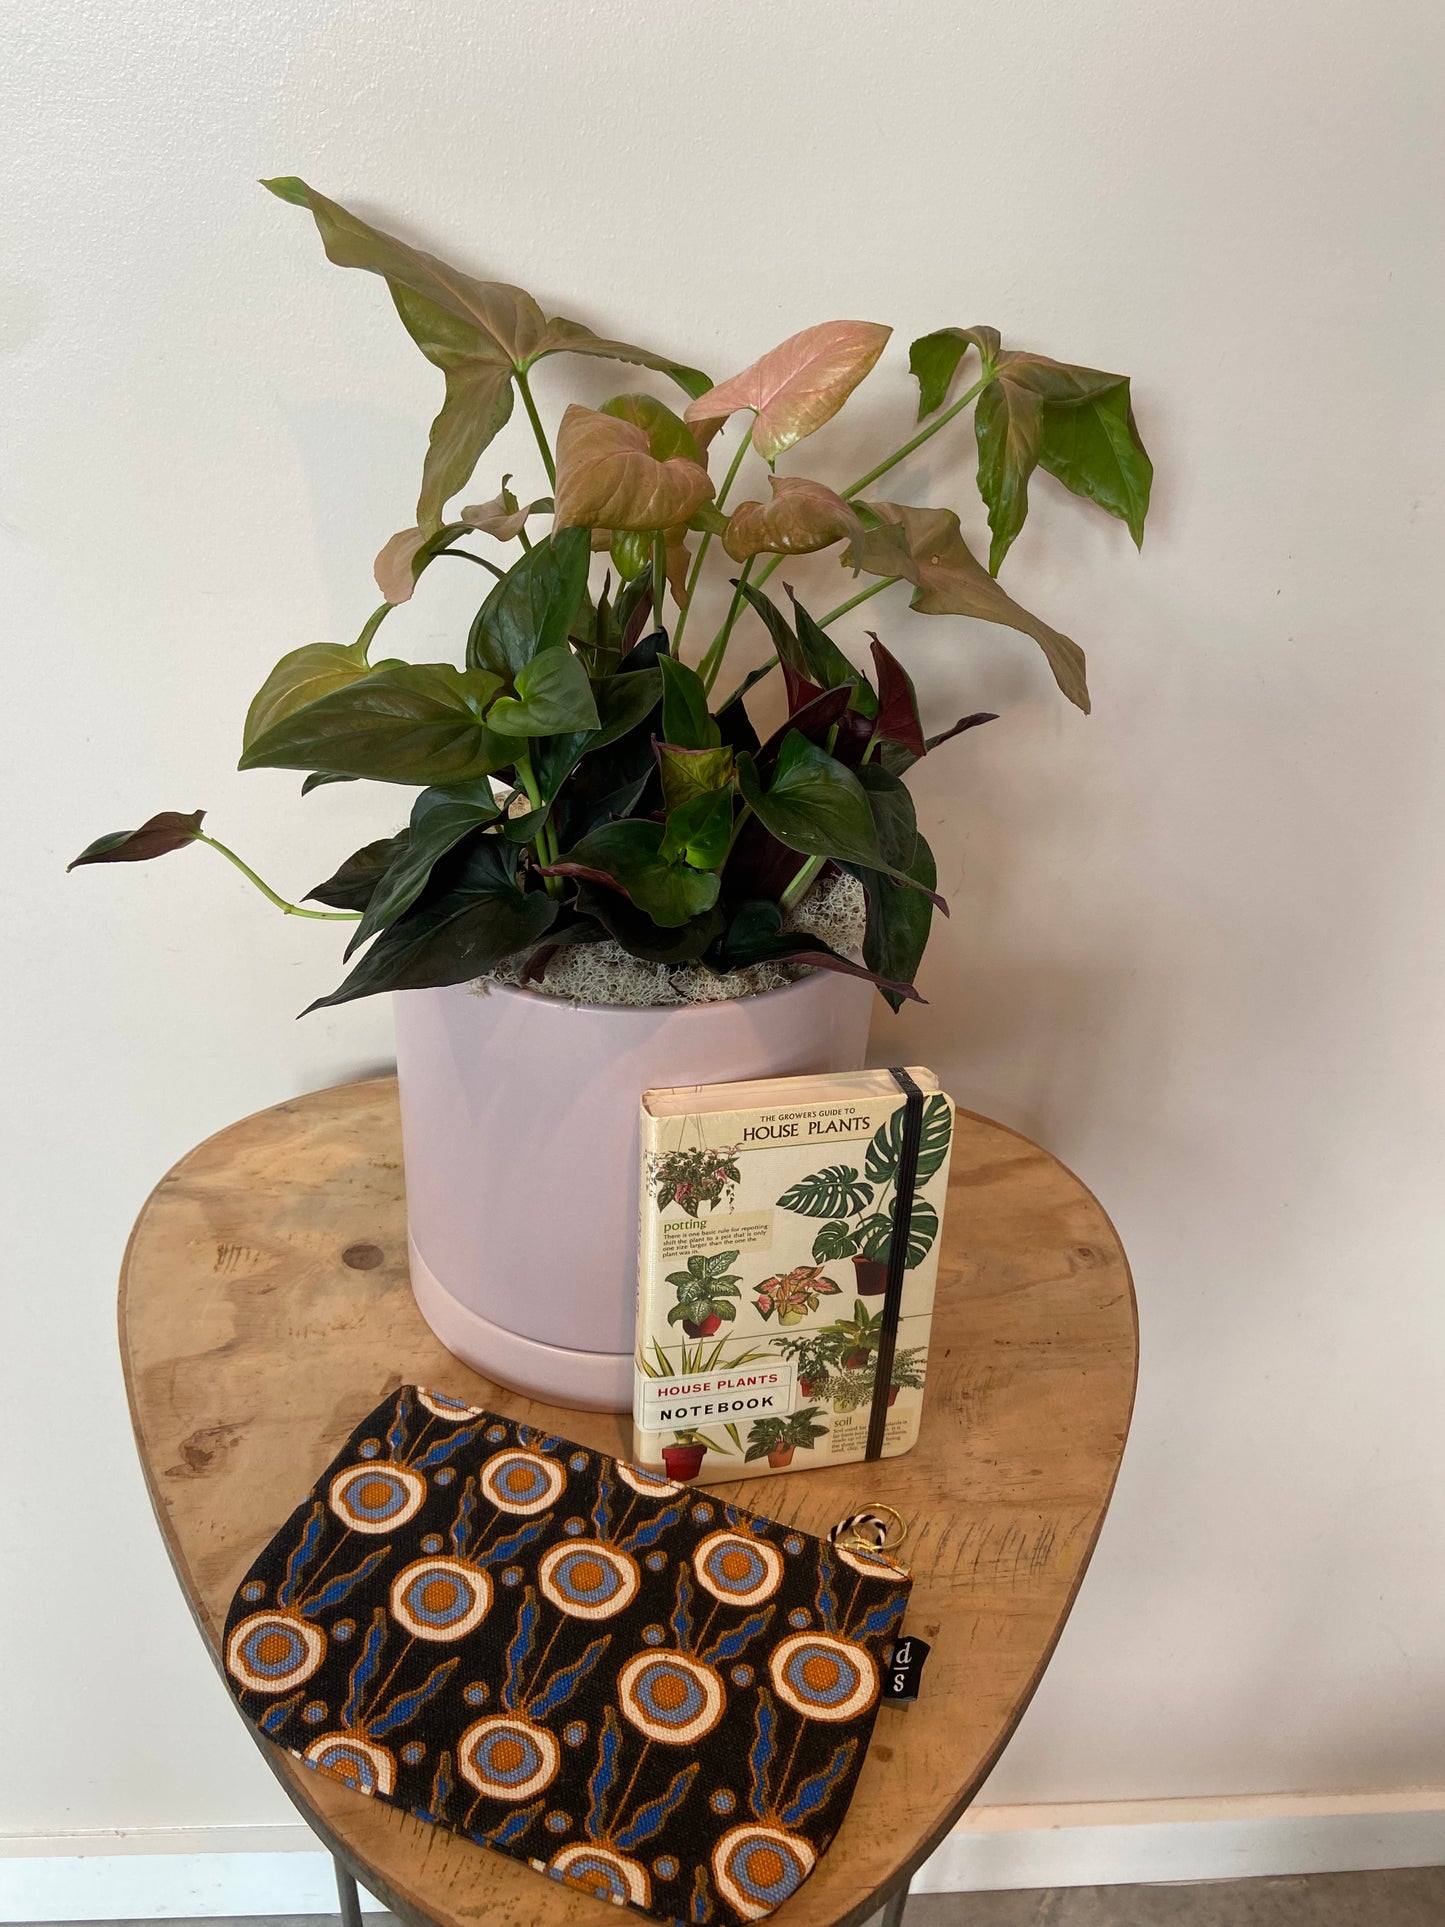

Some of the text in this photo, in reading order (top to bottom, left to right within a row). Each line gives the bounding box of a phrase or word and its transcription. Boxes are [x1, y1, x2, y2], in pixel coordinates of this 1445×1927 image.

[818, 1109, 842, 1118] GUIDE
[844, 1107, 856, 1115] TO
[743, 1116, 871, 1141] HOUSE PLANTS
[664, 1219, 707, 1234] potting
[690, 1236, 705, 1244] plant
[658, 1373, 778, 1397] HOUSE PLANTS
[660, 1396, 774, 1421] NOTEBOOK
[834, 1416, 852, 1427] soil
[895, 1641, 912, 1664] d
